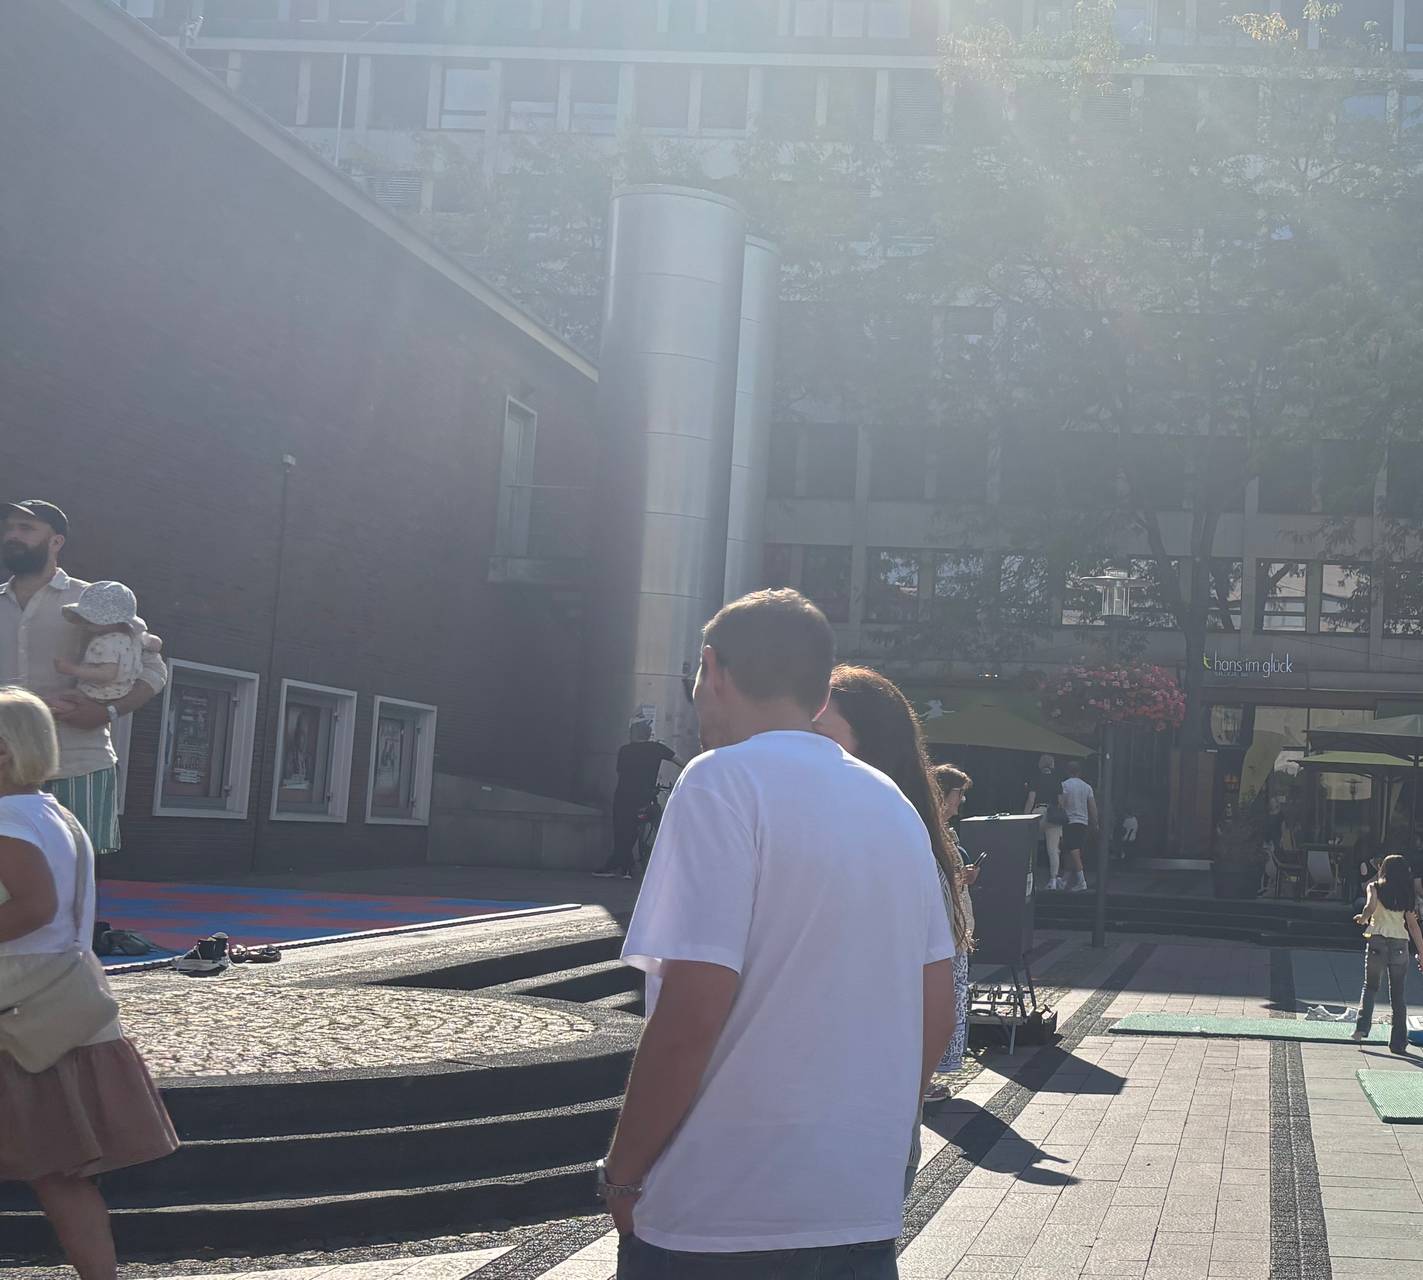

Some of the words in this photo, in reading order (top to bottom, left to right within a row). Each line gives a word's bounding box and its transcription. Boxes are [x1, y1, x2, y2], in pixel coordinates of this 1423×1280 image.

[1214, 649, 1243, 672] hans
[1245, 658, 1260, 672] im
[1262, 651, 1293, 678] glück
